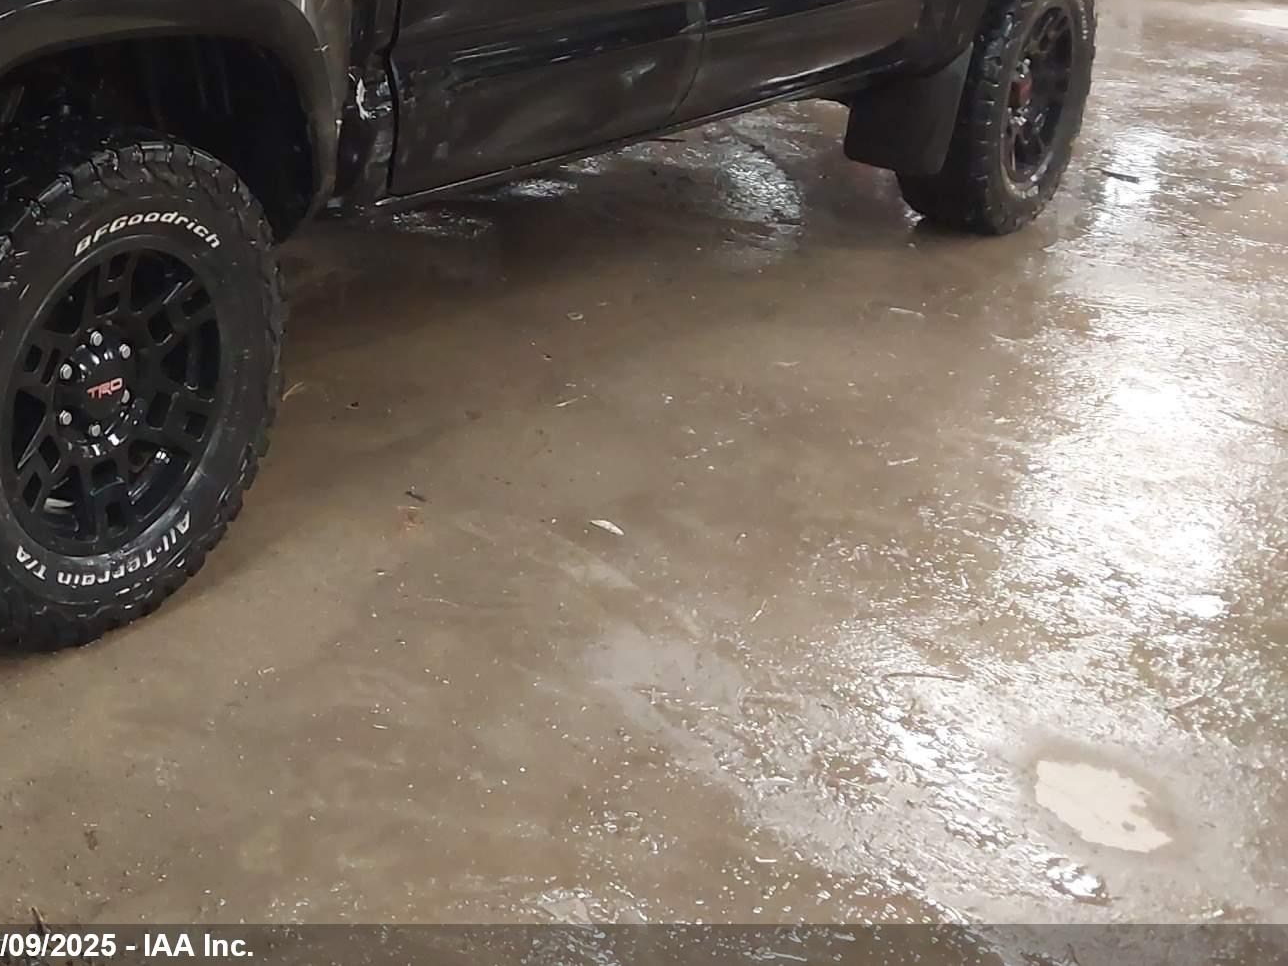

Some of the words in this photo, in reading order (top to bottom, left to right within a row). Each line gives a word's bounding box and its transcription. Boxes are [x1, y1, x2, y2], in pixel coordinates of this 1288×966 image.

[74, 211, 222, 257] BFGoodrich
[87, 377, 123, 399] TRD
[15, 545, 48, 581] T/A
[57, 510, 190, 589] All-Terrain
